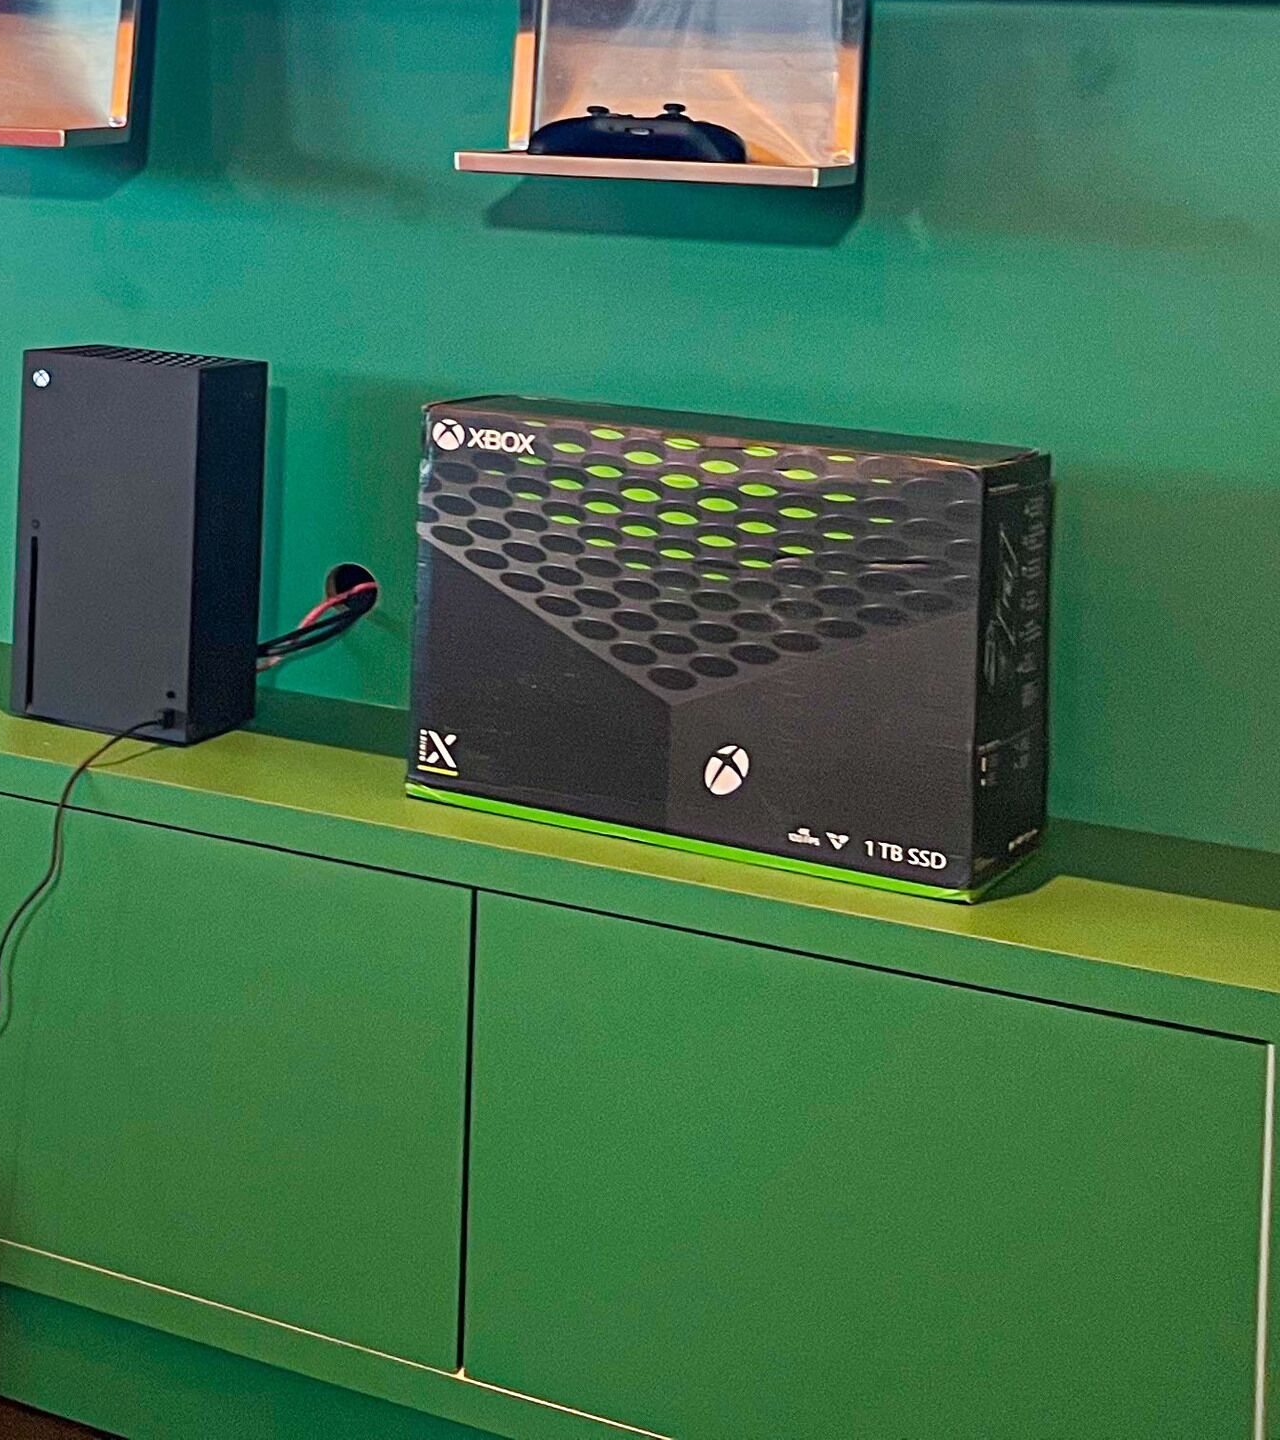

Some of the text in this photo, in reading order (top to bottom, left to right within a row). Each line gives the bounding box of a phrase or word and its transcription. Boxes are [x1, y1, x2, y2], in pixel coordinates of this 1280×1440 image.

[466, 427, 537, 455] XBOX
[864, 840, 948, 870] 1 TB SSD
